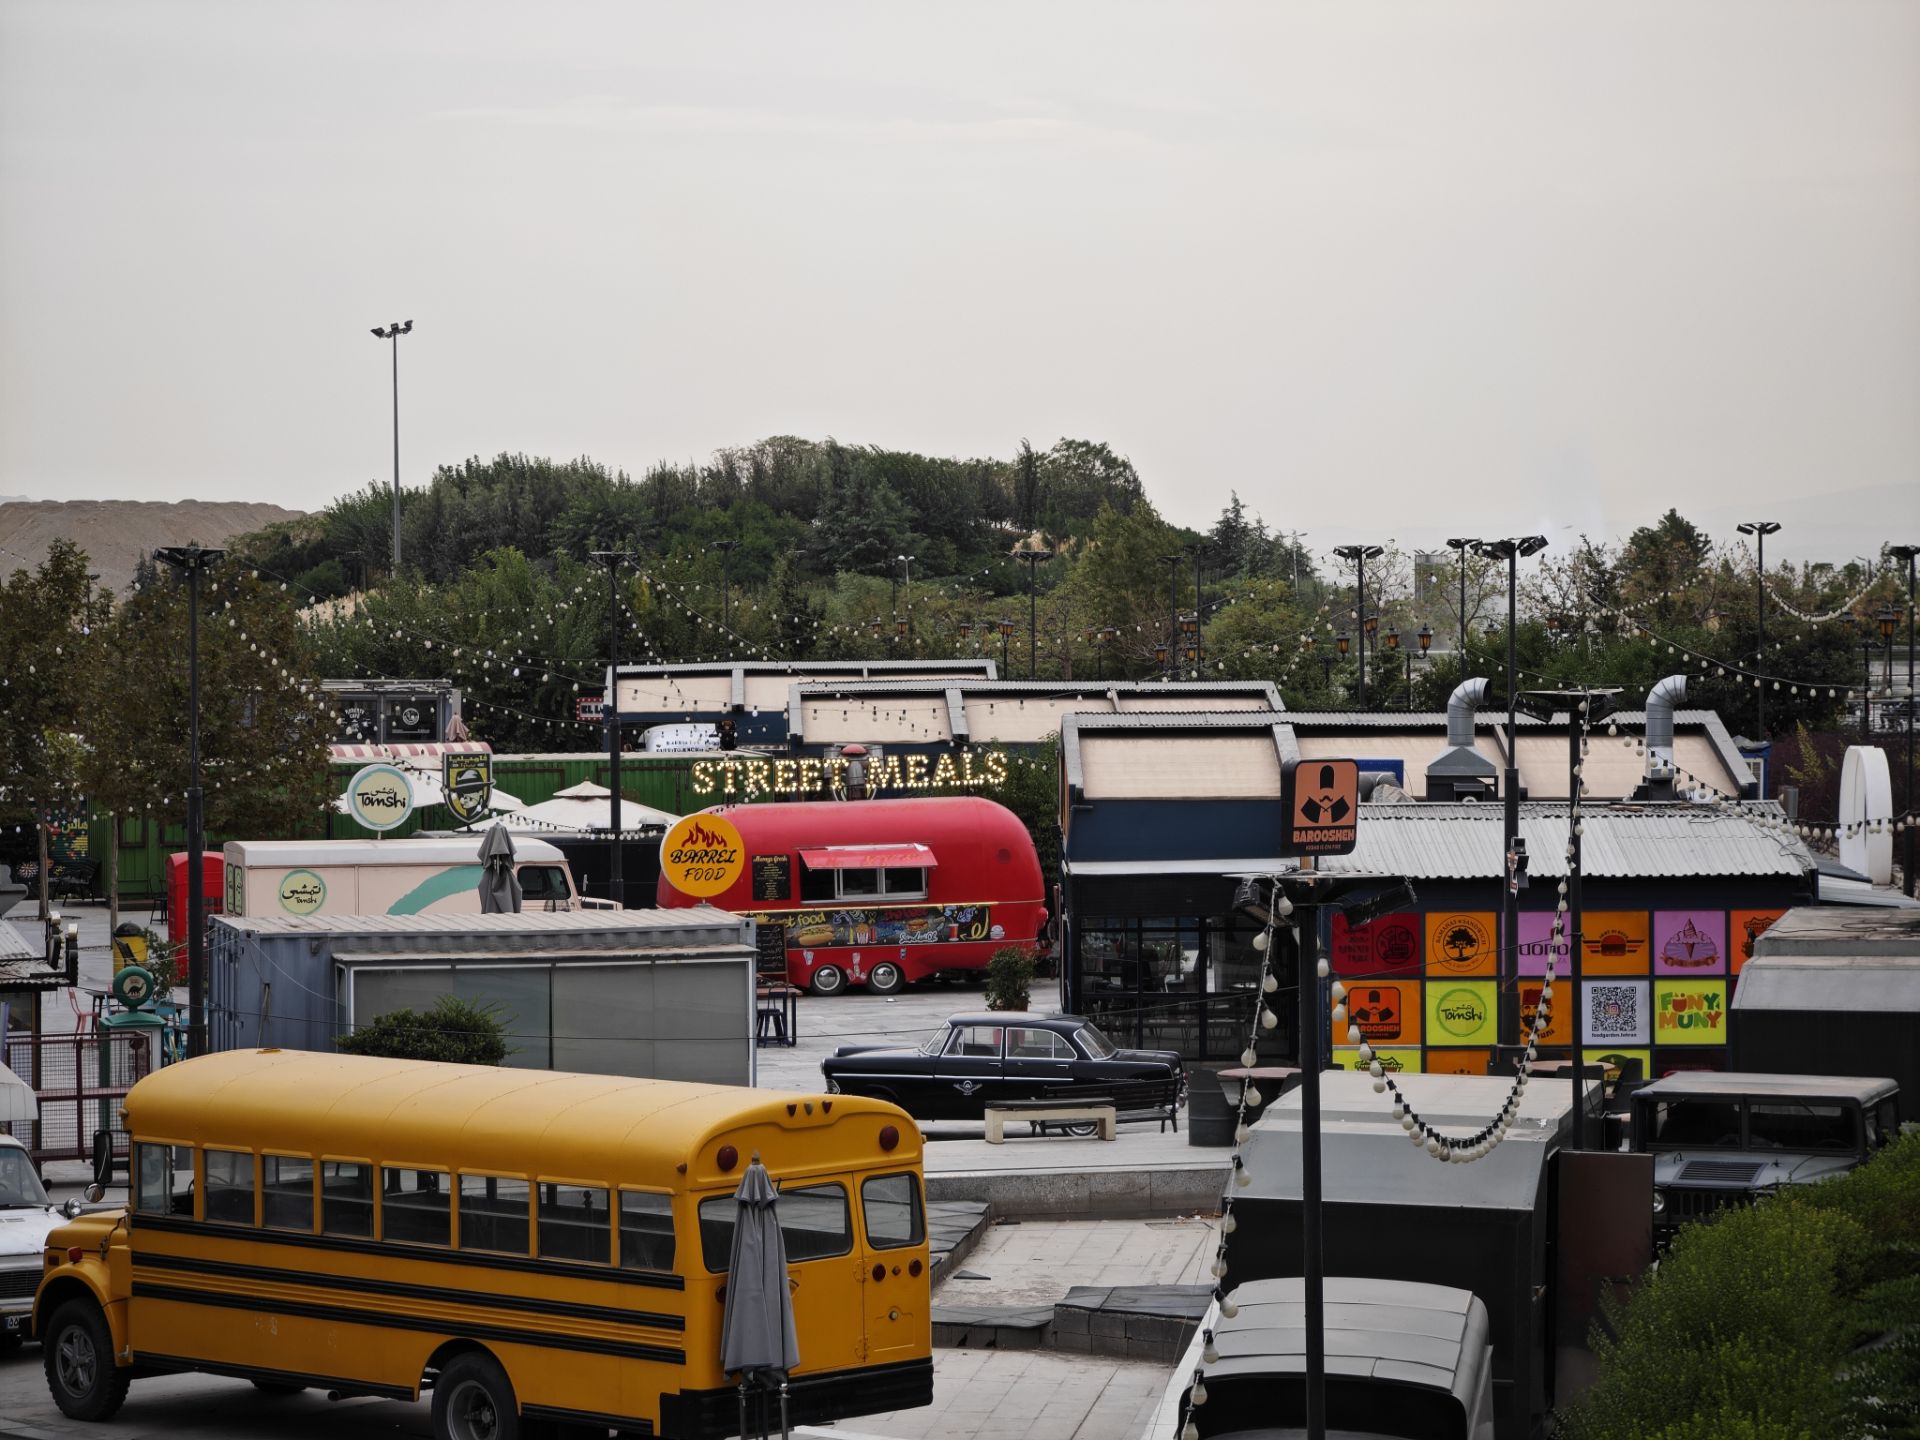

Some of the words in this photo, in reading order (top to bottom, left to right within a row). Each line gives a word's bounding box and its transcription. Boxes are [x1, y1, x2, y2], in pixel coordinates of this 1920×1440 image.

[692, 758, 850, 794] STREET
[865, 752, 1009, 789] MEALS
[1293, 828, 1355, 843] BAROOSHEH
[670, 848, 737, 865] BARREL
[684, 867, 726, 881] FOOD
[797, 911, 826, 926] food
[1360, 1023, 1400, 1033] ROOSHEH
[1658, 1011, 1722, 1030] MUNY
